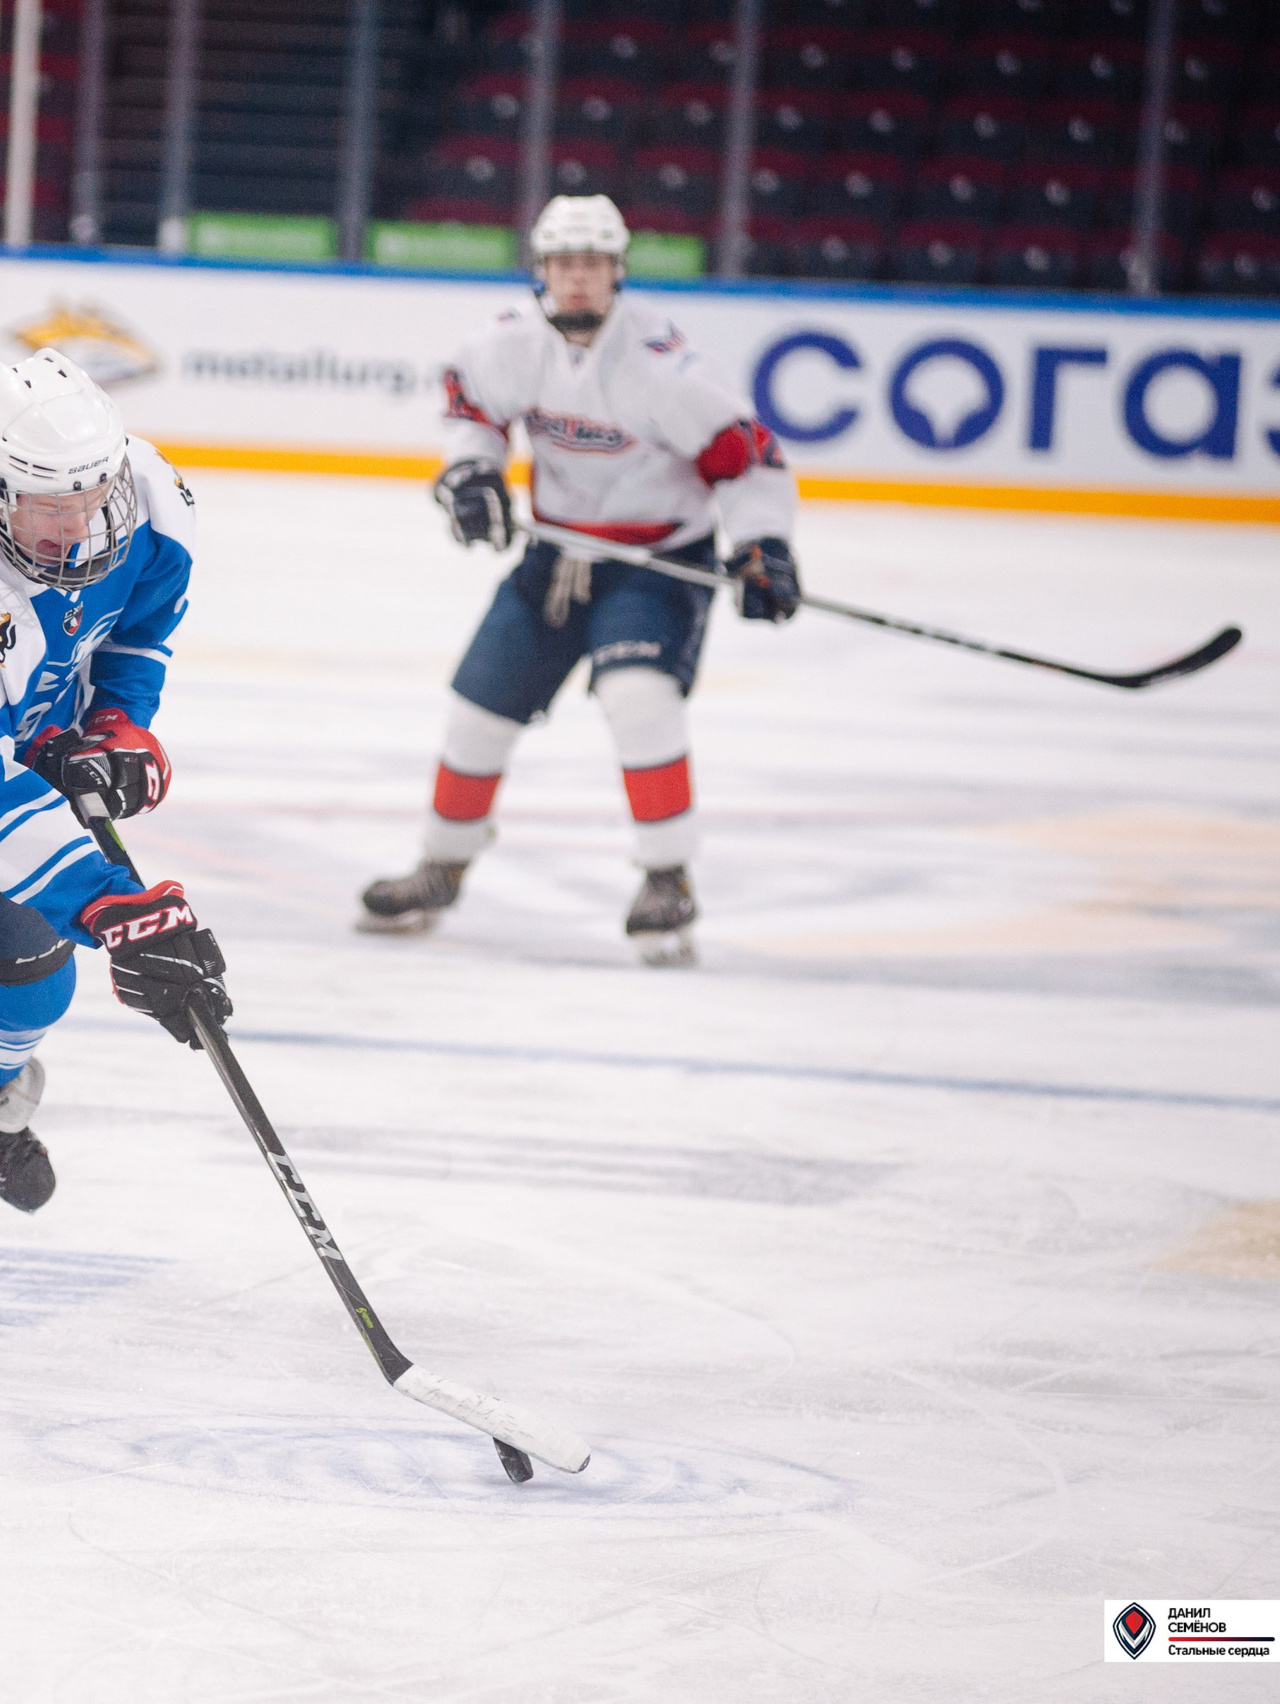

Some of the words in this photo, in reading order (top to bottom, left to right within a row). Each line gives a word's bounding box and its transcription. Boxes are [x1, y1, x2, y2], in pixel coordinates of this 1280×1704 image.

[752, 328, 1280, 462] сога
[100, 905, 194, 950] CCM
[267, 1152, 344, 1261] CCM
